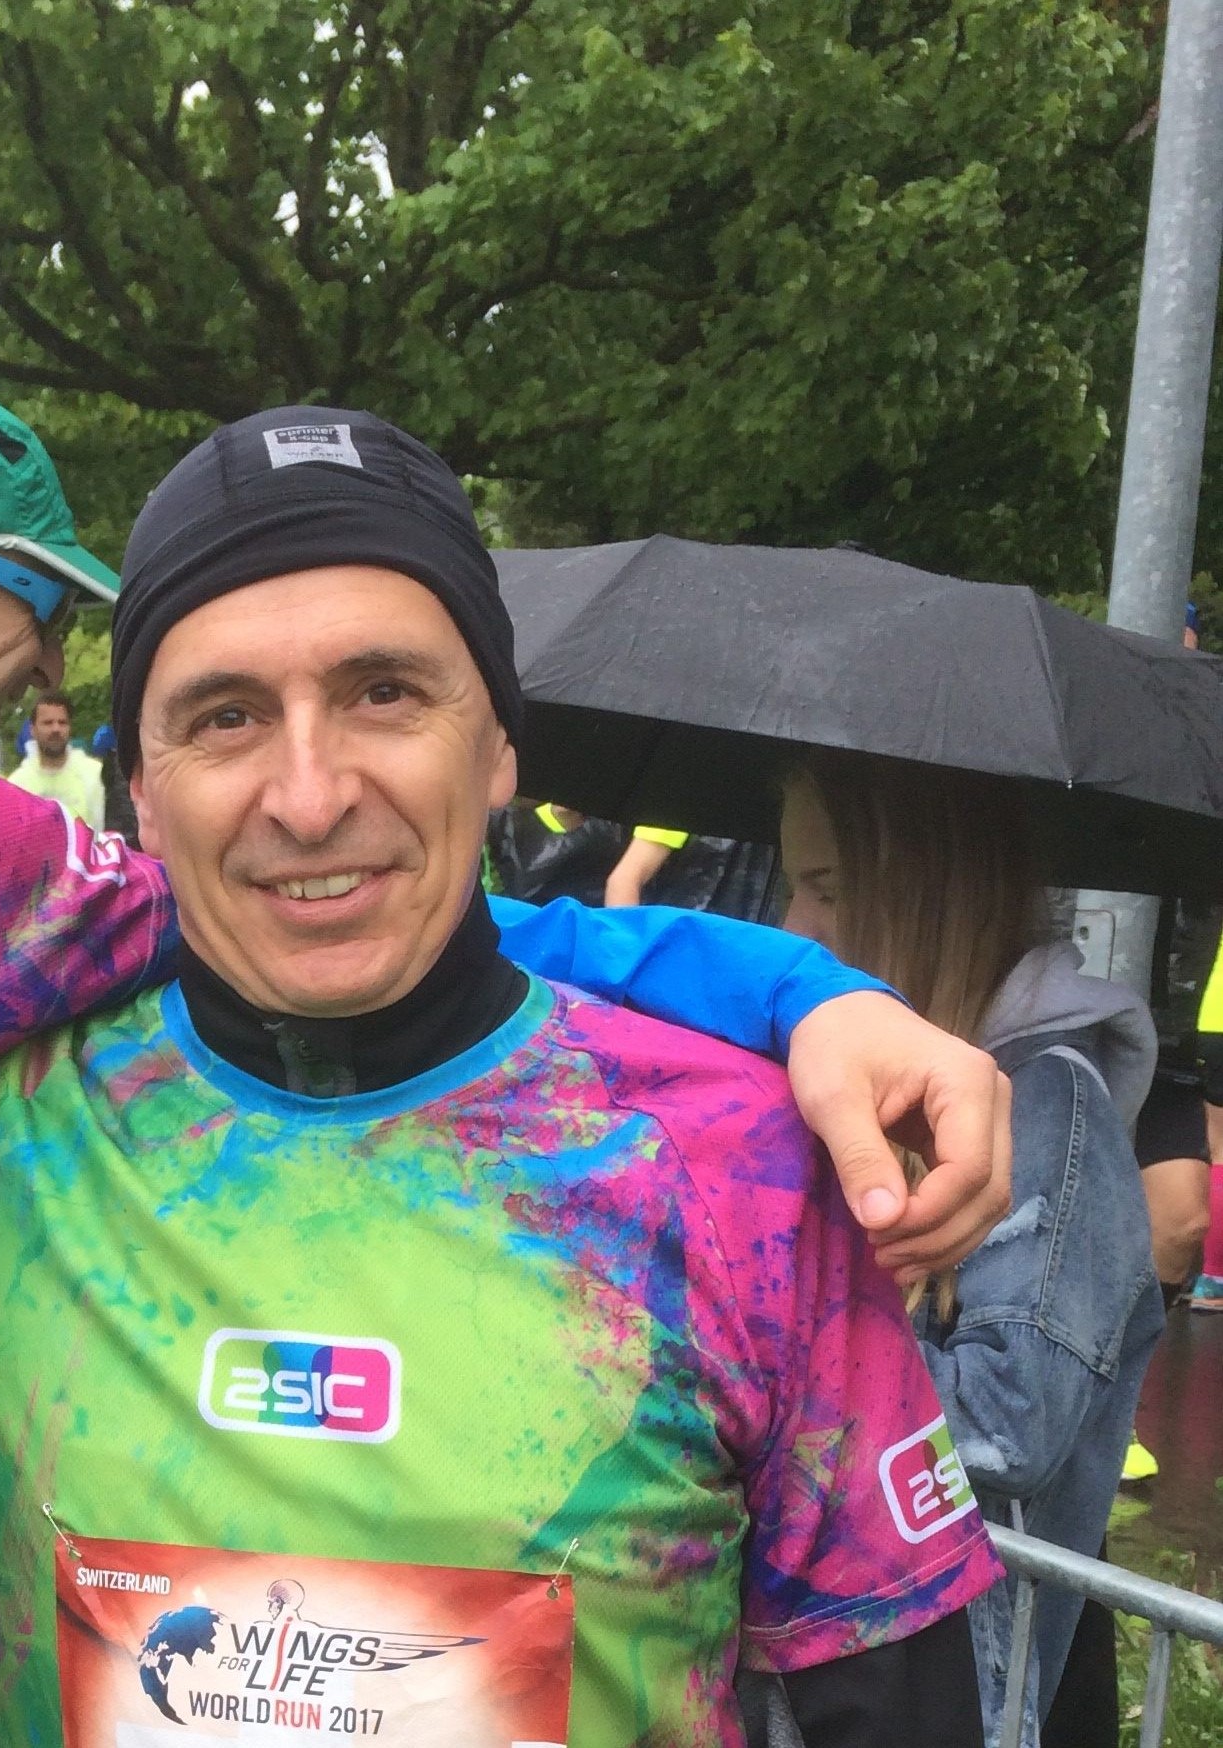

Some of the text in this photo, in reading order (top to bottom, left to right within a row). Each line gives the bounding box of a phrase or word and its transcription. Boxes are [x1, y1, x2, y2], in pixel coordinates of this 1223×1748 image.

[76, 1566, 171, 1595] SWITZERLAND
[217, 1656, 250, 1671] FOR
[329, 1706, 384, 1735] 2017
